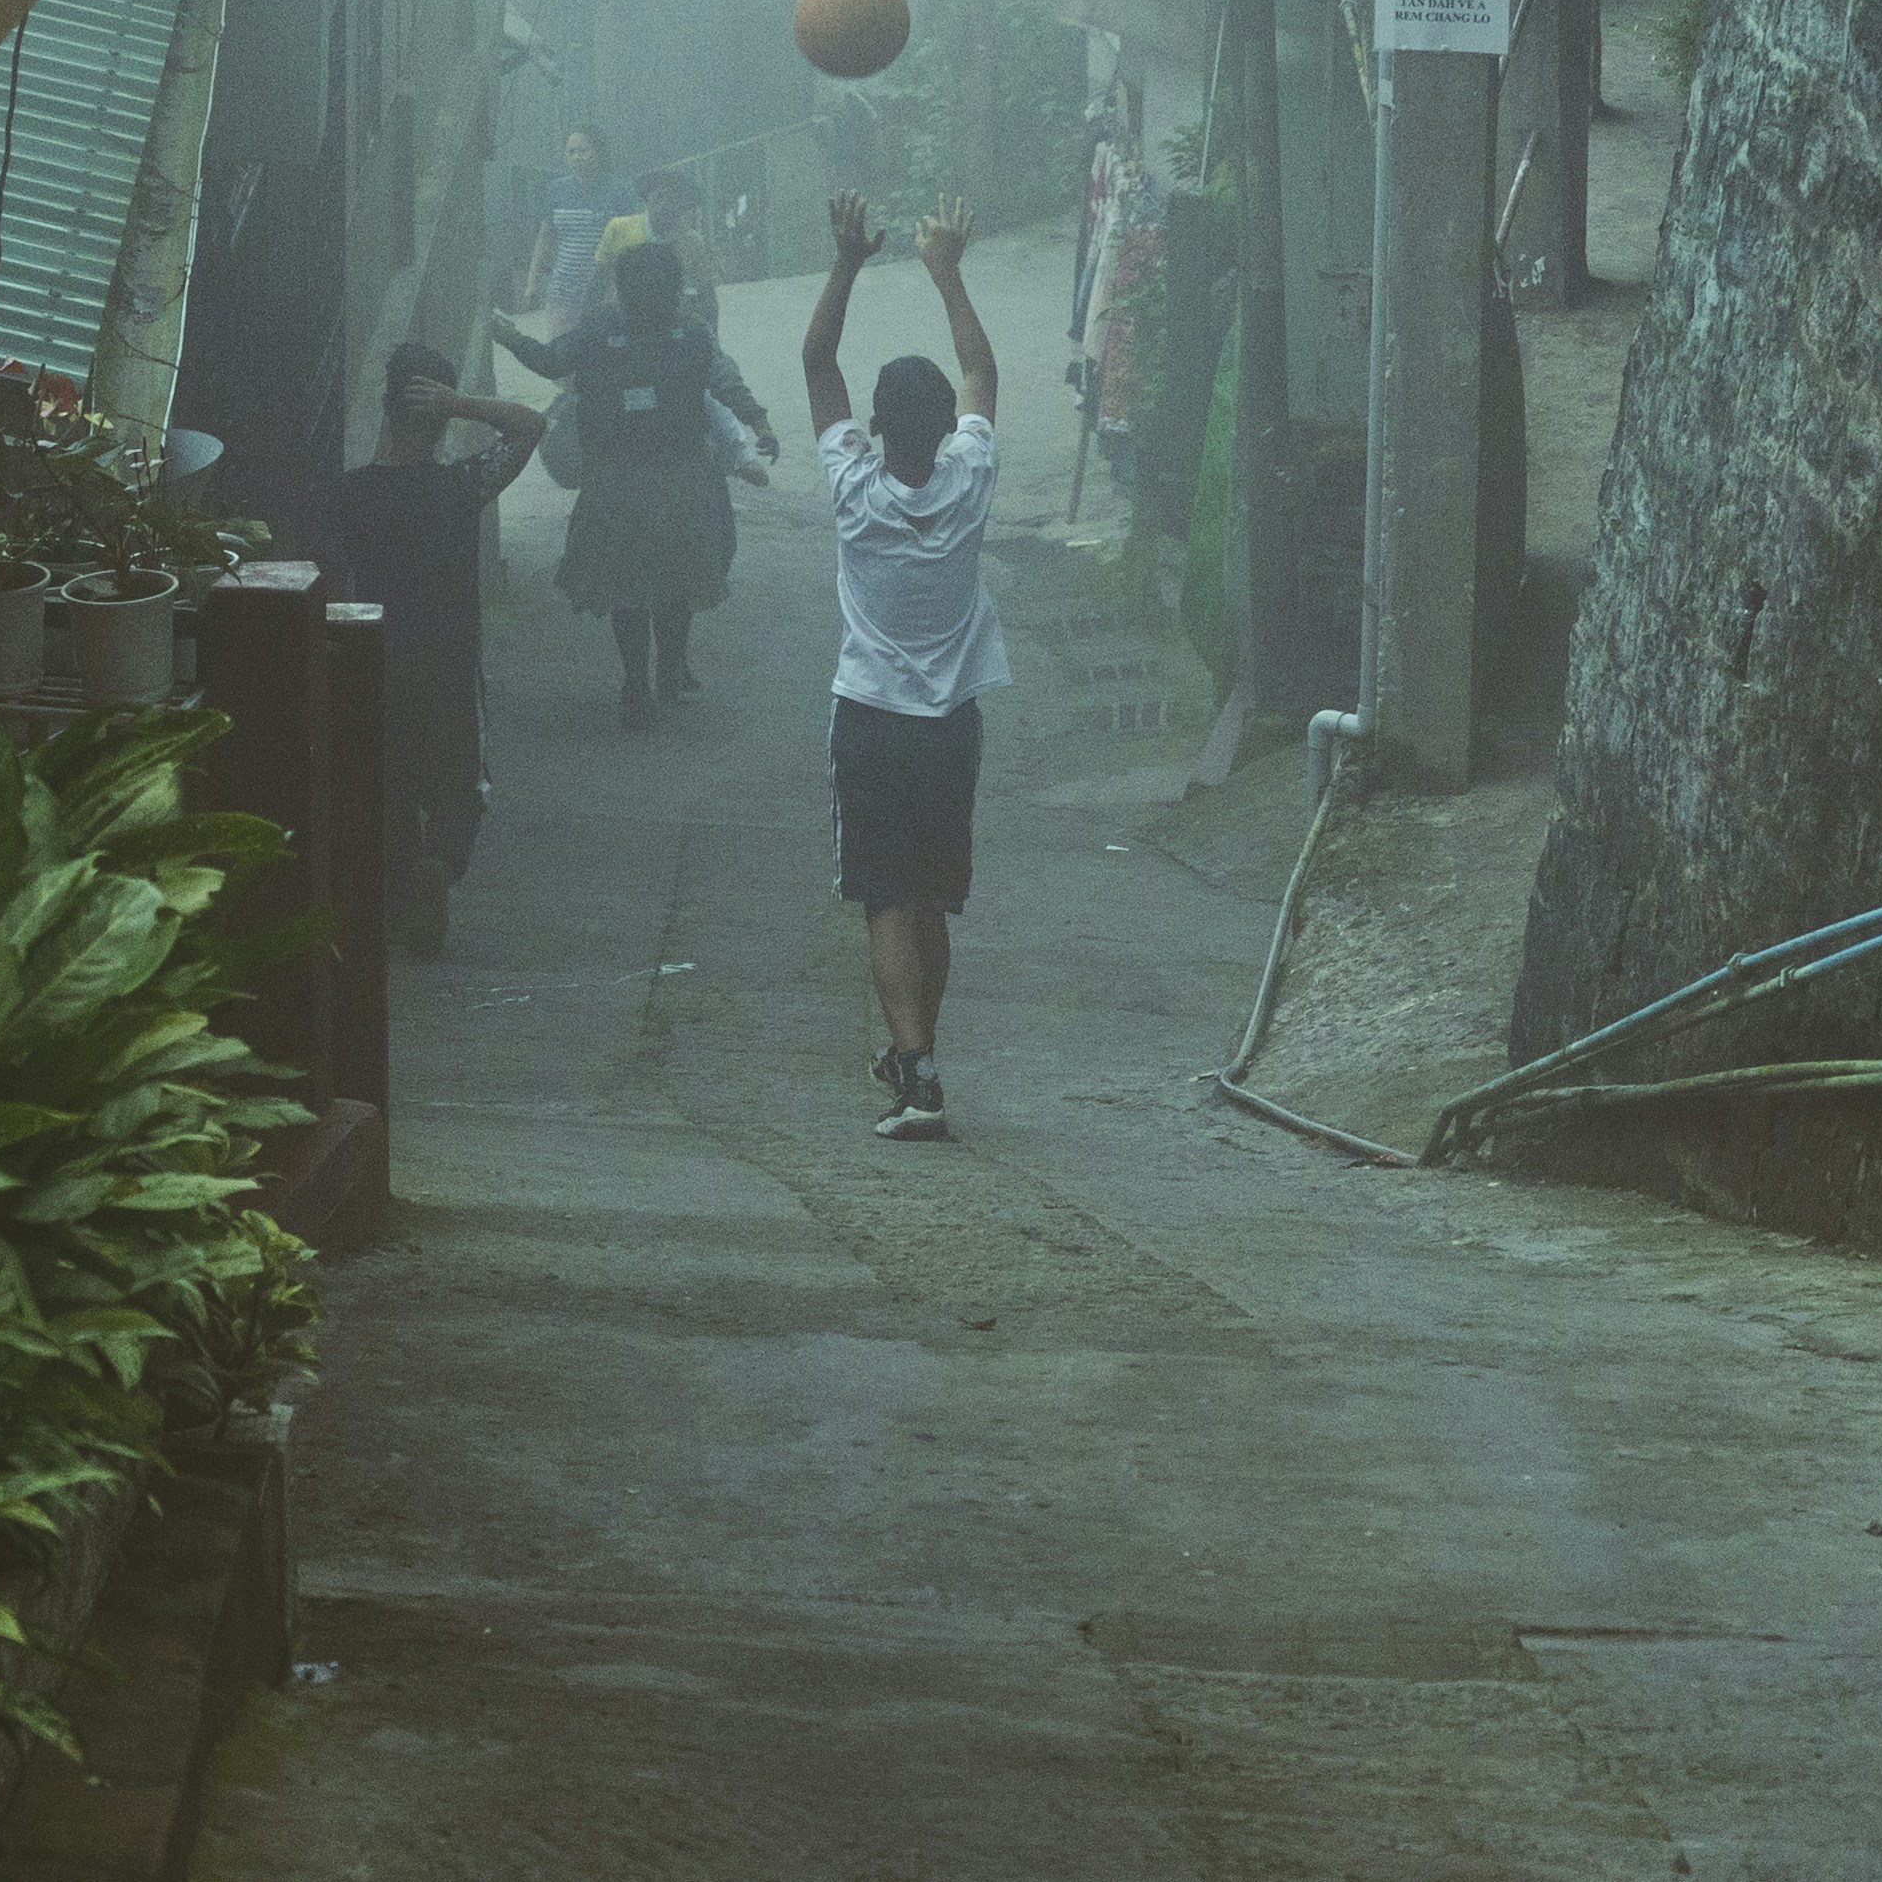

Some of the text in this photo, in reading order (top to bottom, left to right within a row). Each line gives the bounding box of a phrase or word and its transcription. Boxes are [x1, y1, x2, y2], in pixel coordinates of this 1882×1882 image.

[1457, 0, 1475, 10] VE
[1476, 0, 1487, 10] A
[1394, 10, 1491, 24] REM CHANG LO
